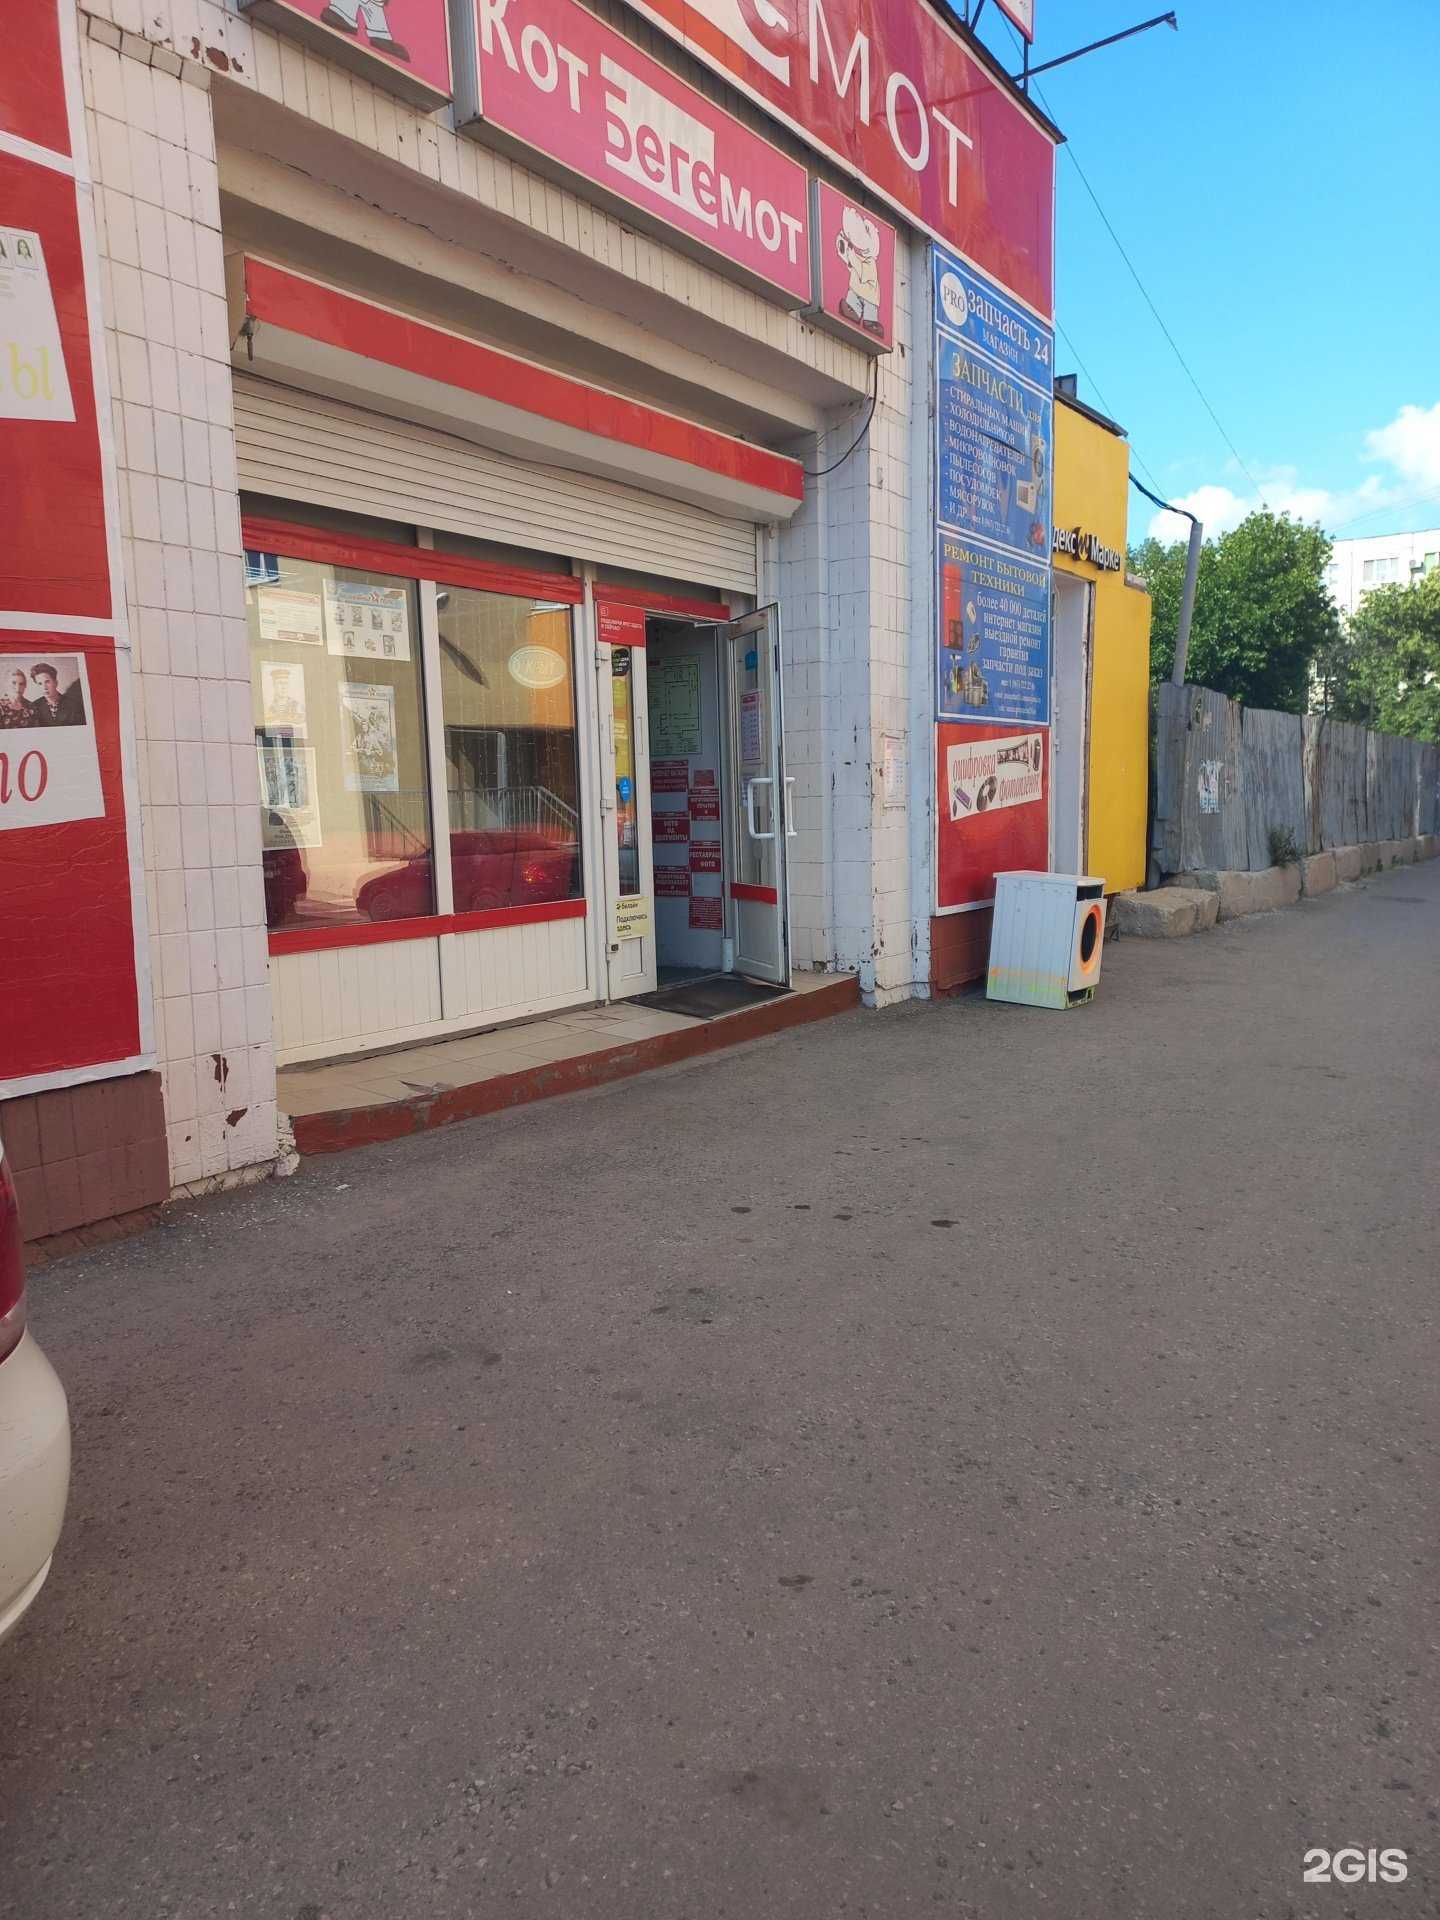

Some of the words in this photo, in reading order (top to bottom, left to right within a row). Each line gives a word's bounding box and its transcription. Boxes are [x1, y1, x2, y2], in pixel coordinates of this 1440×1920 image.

[480, 0, 589, 114] Кот
[943, 285, 965, 314] PRO
[1034, 337, 1049, 366] 24
[952, 352, 1024, 414] ЗАПЧАСТИ
[950, 387, 1000, 422] СТИРАЛЬНЫХ
[944, 543, 995, 570] РЕМОНТ
[997, 560, 1047, 589] БЫТОВОЙ
[1090, 534, 1120, 571] Марке
[972, 570, 1025, 597] ТЕХНИКИ
